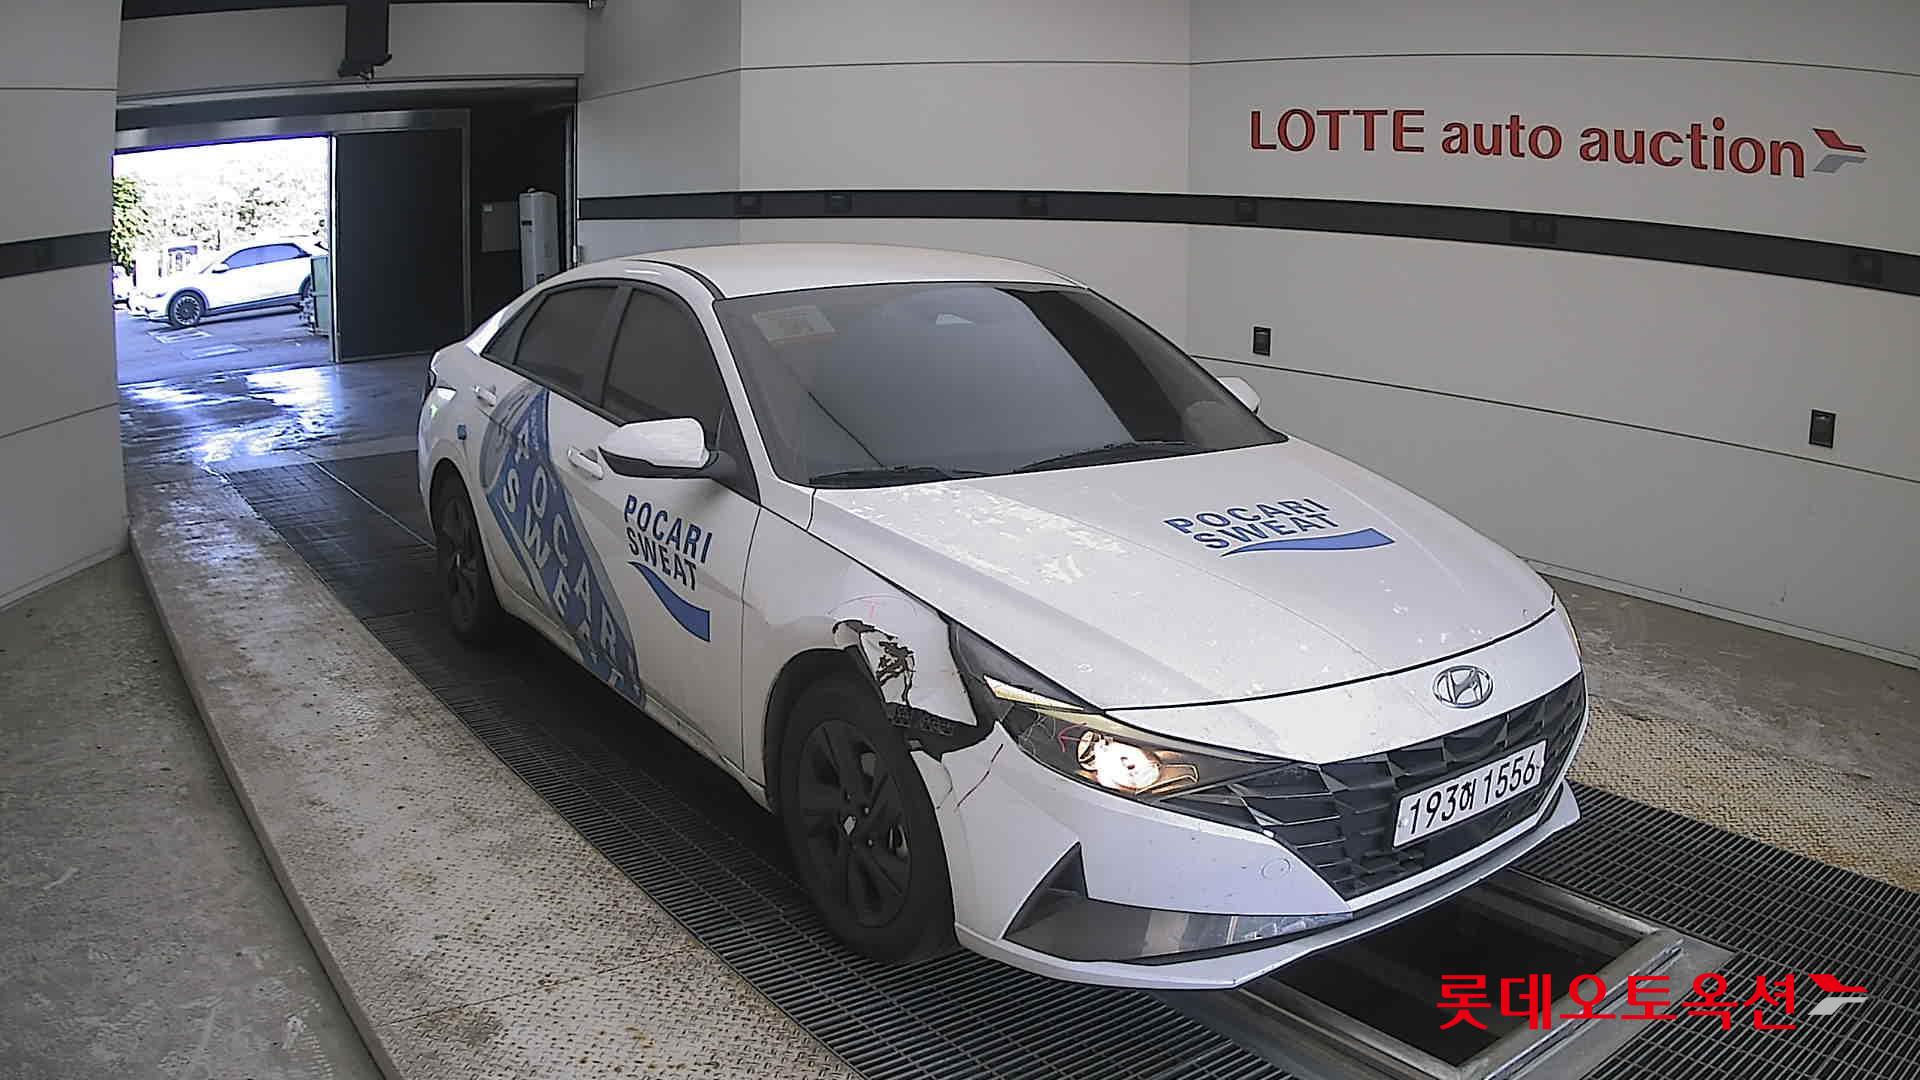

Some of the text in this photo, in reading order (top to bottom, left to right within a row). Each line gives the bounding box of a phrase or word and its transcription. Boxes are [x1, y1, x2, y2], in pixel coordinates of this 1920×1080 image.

[1250, 109, 1806, 179] LOTTE auto auction
[624, 494, 713, 563] POCARI
[1163, 498, 1331, 534] POCARI
[1193, 513, 1339, 549] SWEAT
[626, 526, 698, 591] SWEAT
[1409, 750, 1536, 835] 193허 1556
